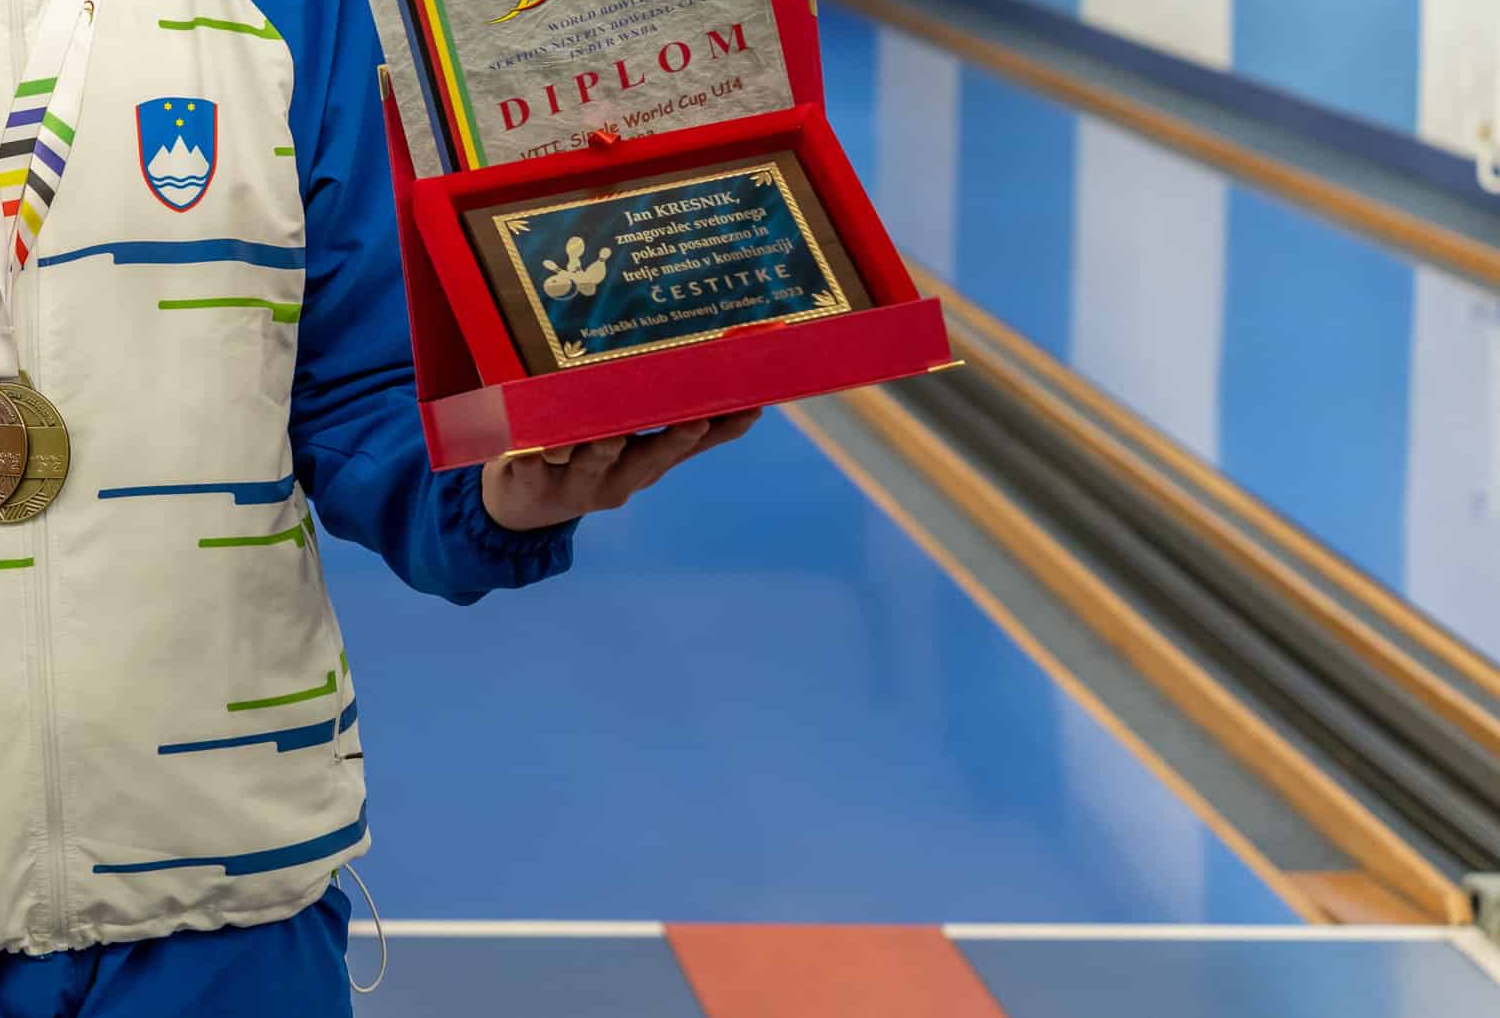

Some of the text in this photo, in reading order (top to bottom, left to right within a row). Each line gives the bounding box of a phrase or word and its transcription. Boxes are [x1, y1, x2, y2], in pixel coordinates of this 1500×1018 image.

[499, 22, 750, 132] DIPLOM
[571, 121, 620, 148] Sile
[622, 99, 675, 129] World
[678, 88, 708, 110] Cup
[711, 75, 744, 98] U14
[614, 206, 768, 246] zmagovalec svetovnega
[624, 190, 741, 227] Jan KRESNIK,
[622, 237, 794, 283] tretje mesto v kombinaciji
[631, 224, 770, 265] pokala posamezno in
[651, 263, 791, 304] ČESTITKE
[639, 314, 670, 328] klub
[671, 302, 719, 322] Slovenj
